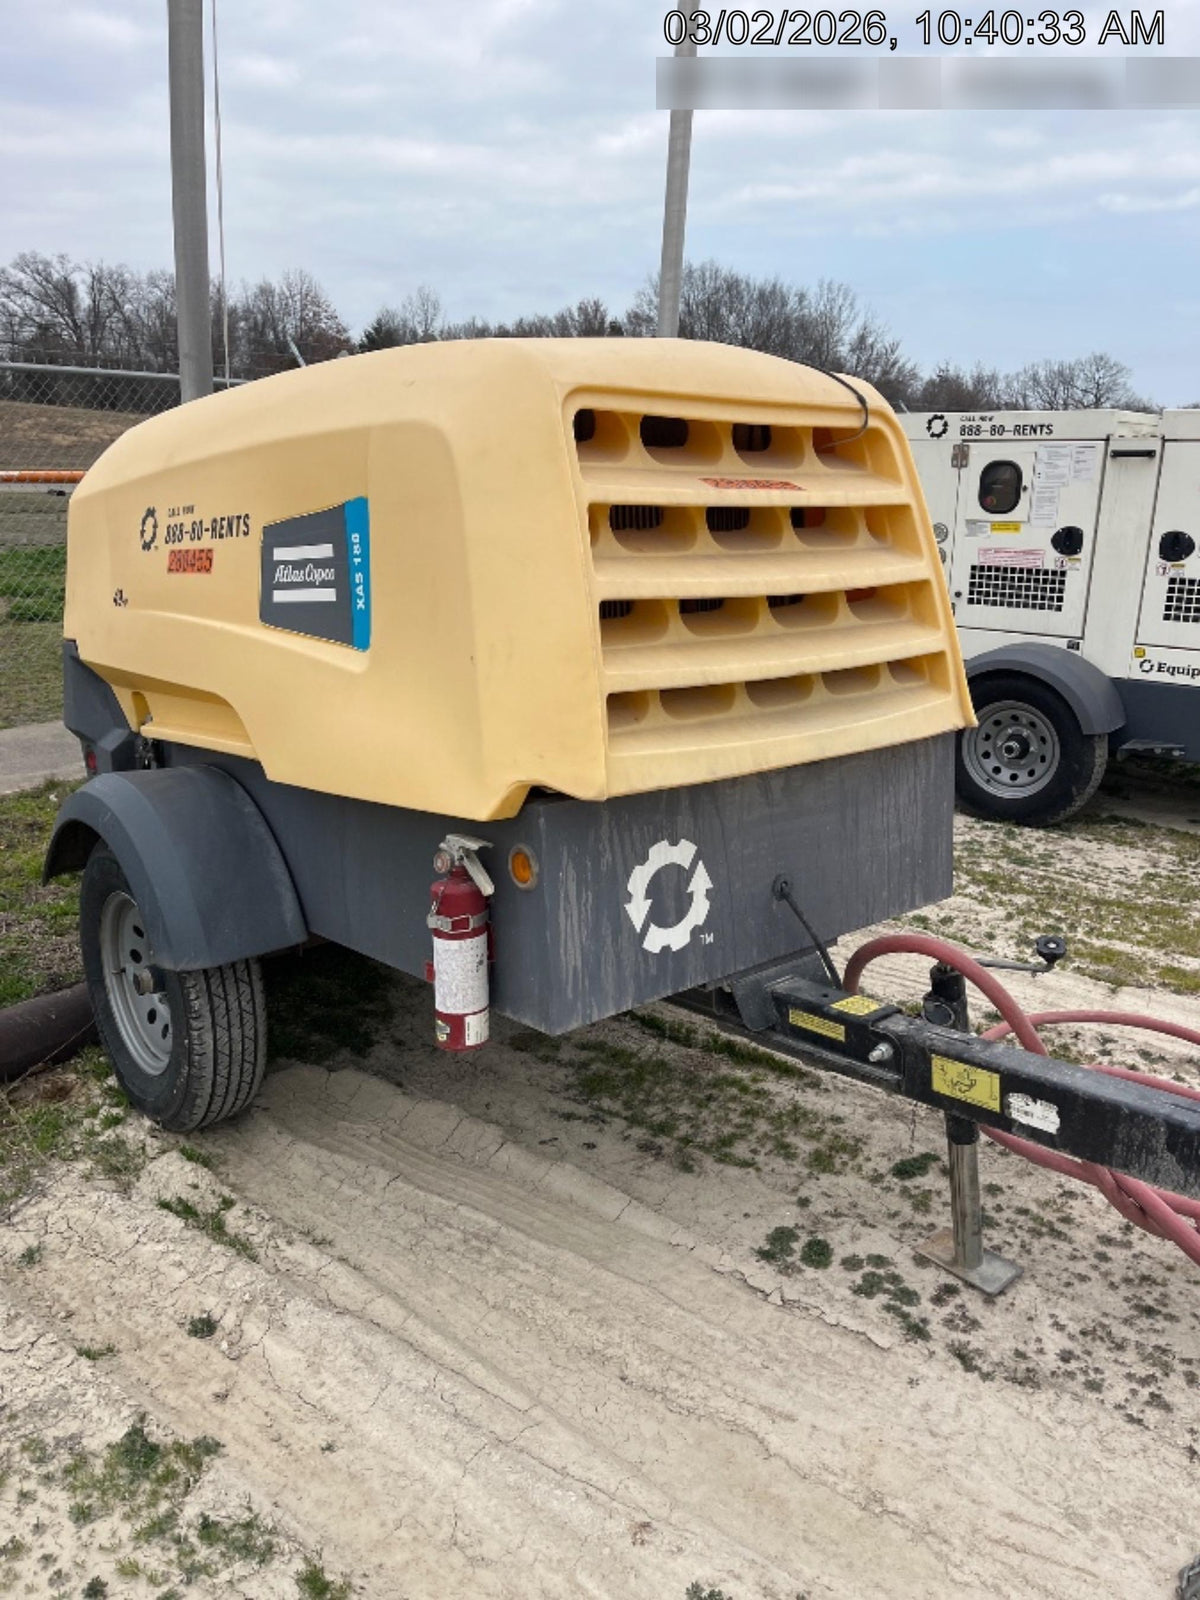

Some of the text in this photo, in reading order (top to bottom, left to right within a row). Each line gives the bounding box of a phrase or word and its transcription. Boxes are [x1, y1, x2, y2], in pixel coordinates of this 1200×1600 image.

[959, 423, 1054, 436] 888-80-RENTS
[164, 513, 251, 544] 888-80-RENTS
[273, 562, 335, 586] Atlas Copco
[351, 532, 366, 611] XAS 180
